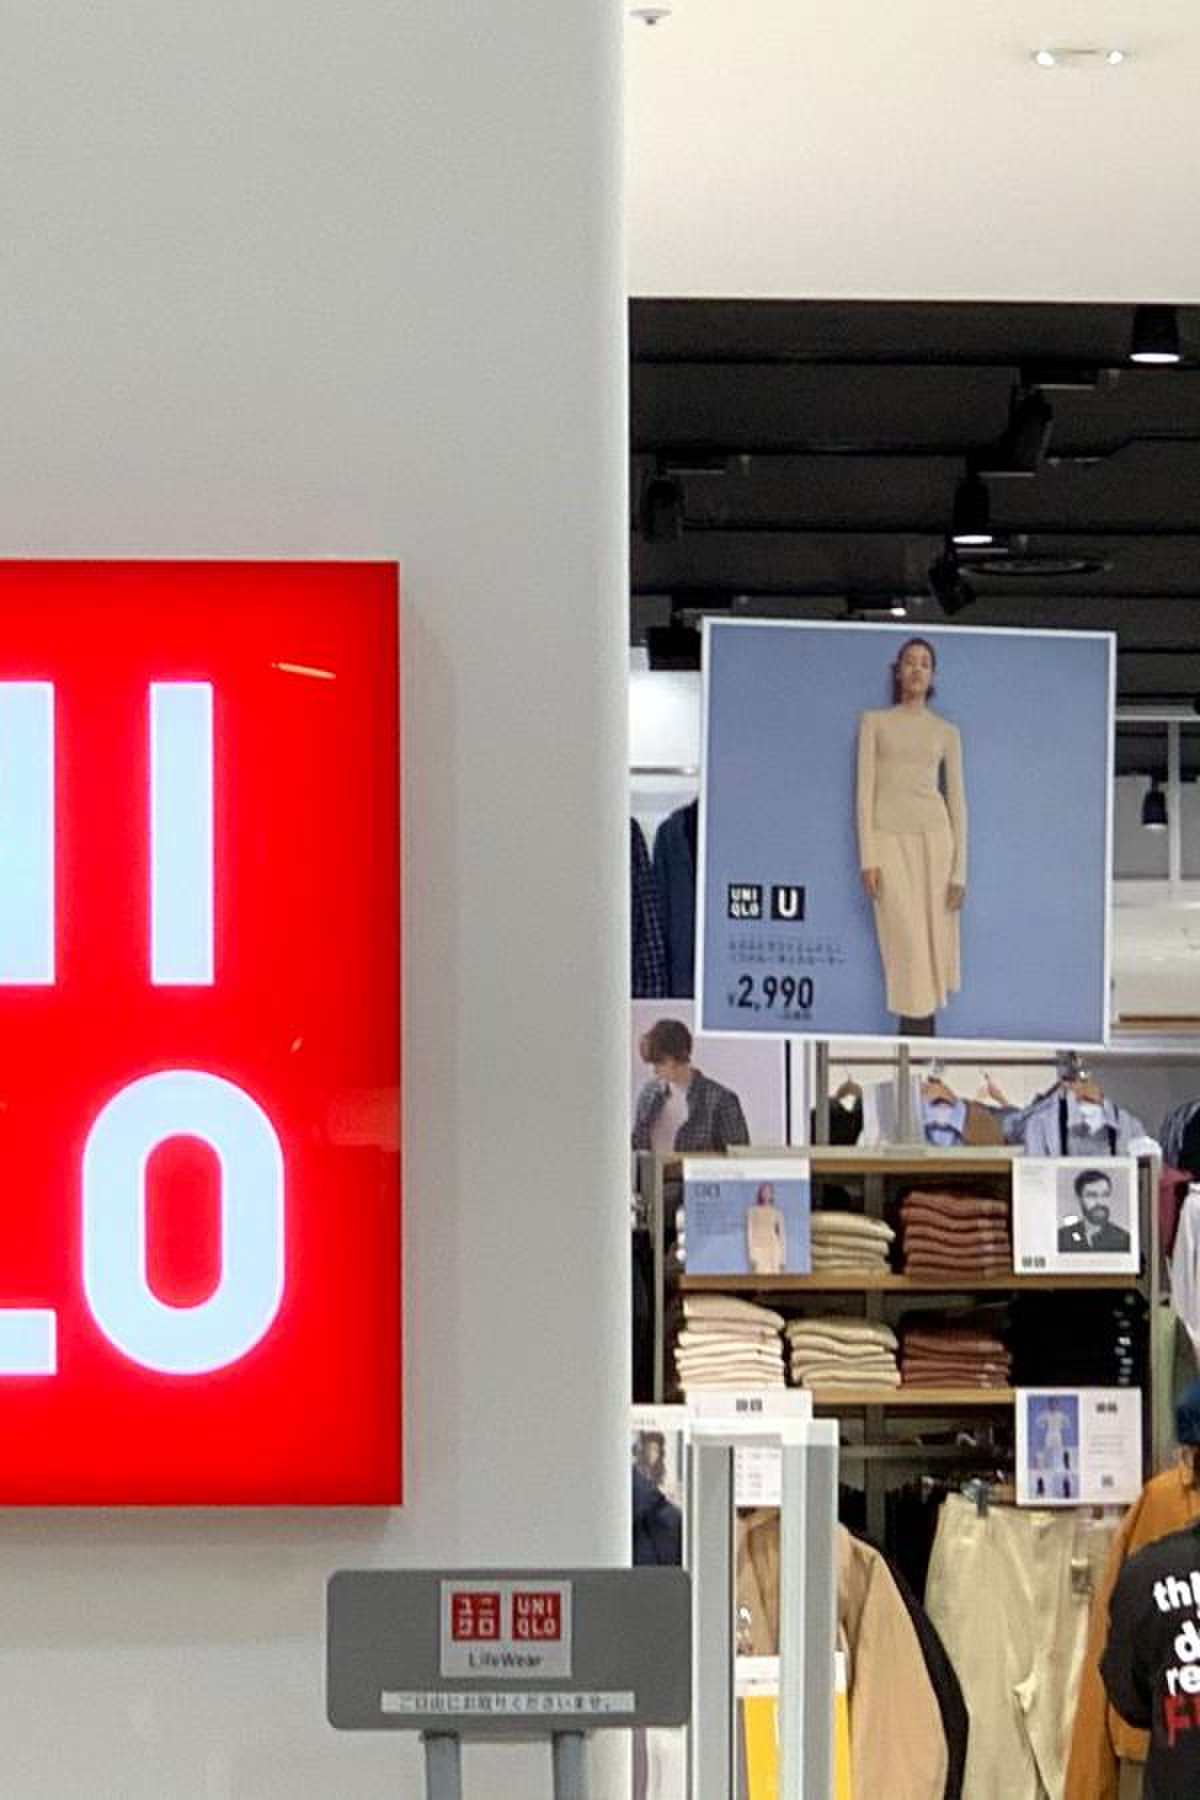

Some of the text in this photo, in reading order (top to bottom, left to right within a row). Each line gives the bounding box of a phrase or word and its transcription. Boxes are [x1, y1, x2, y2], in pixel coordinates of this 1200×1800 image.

[730, 887, 759, 900] UNI
[778, 888, 798, 917] U
[517, 1596, 553, 1615] UNI
[517, 1618, 557, 1638] QLO
[468, 1651, 544, 1669] LifeWear
